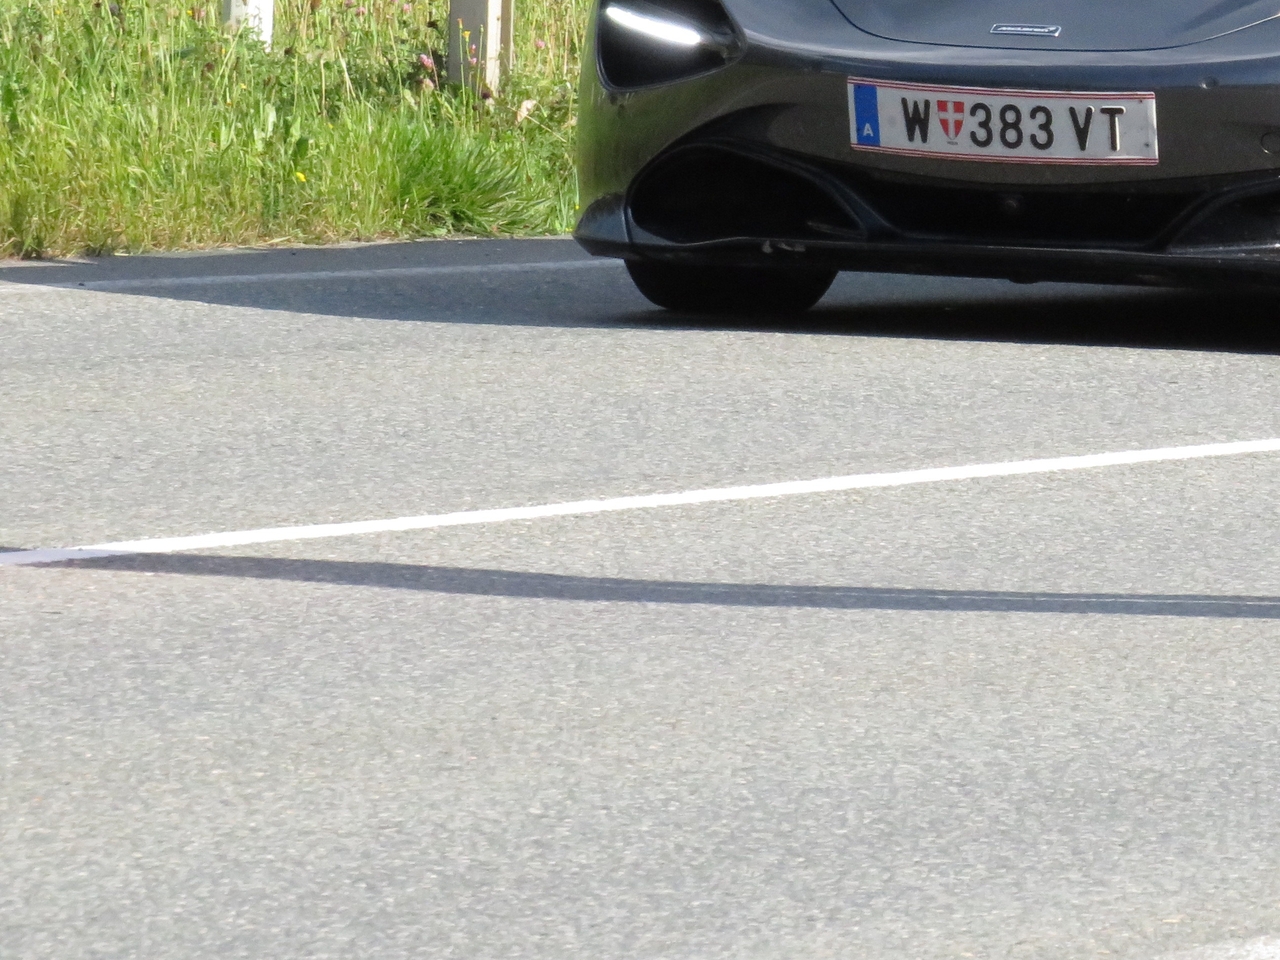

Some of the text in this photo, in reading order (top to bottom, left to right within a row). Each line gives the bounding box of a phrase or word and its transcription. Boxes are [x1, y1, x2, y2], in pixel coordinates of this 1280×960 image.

[863, 123, 874, 137] A
[902, 97, 1126, 152] W 383 VT
